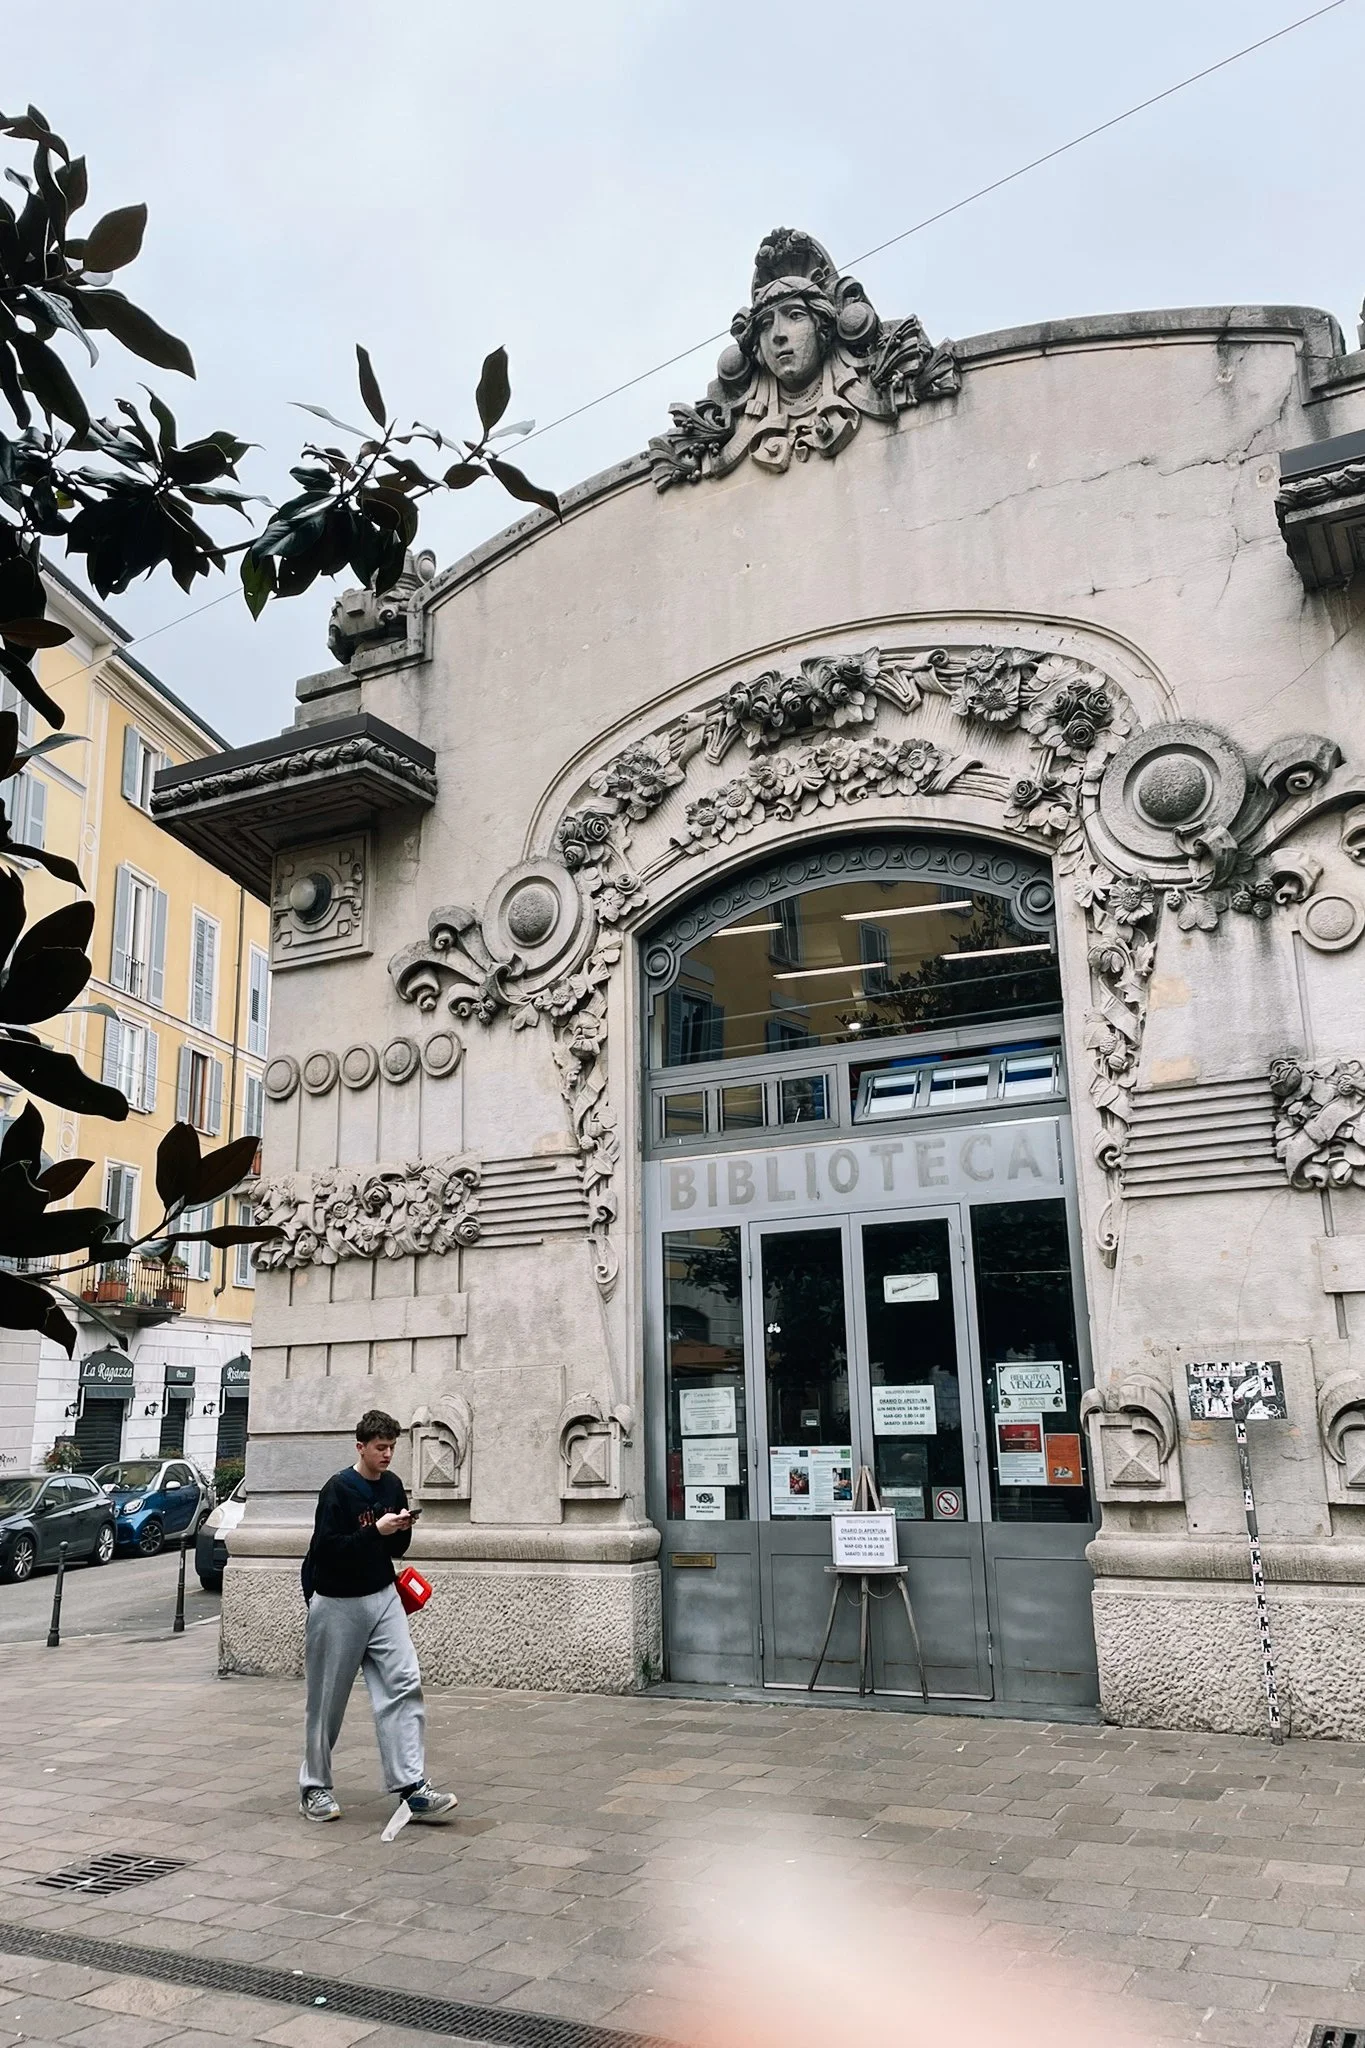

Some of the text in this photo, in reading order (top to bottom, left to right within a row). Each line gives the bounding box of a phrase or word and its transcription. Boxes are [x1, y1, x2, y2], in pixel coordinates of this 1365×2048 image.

[670, 1130, 1042, 1212] BIBLIOTECA
[83, 1362, 133, 1383] La Ragazza
[1010, 1373, 1051, 1381] BIBLIOTECA
[1010, 1380, 1052, 1389] VENEZIA
